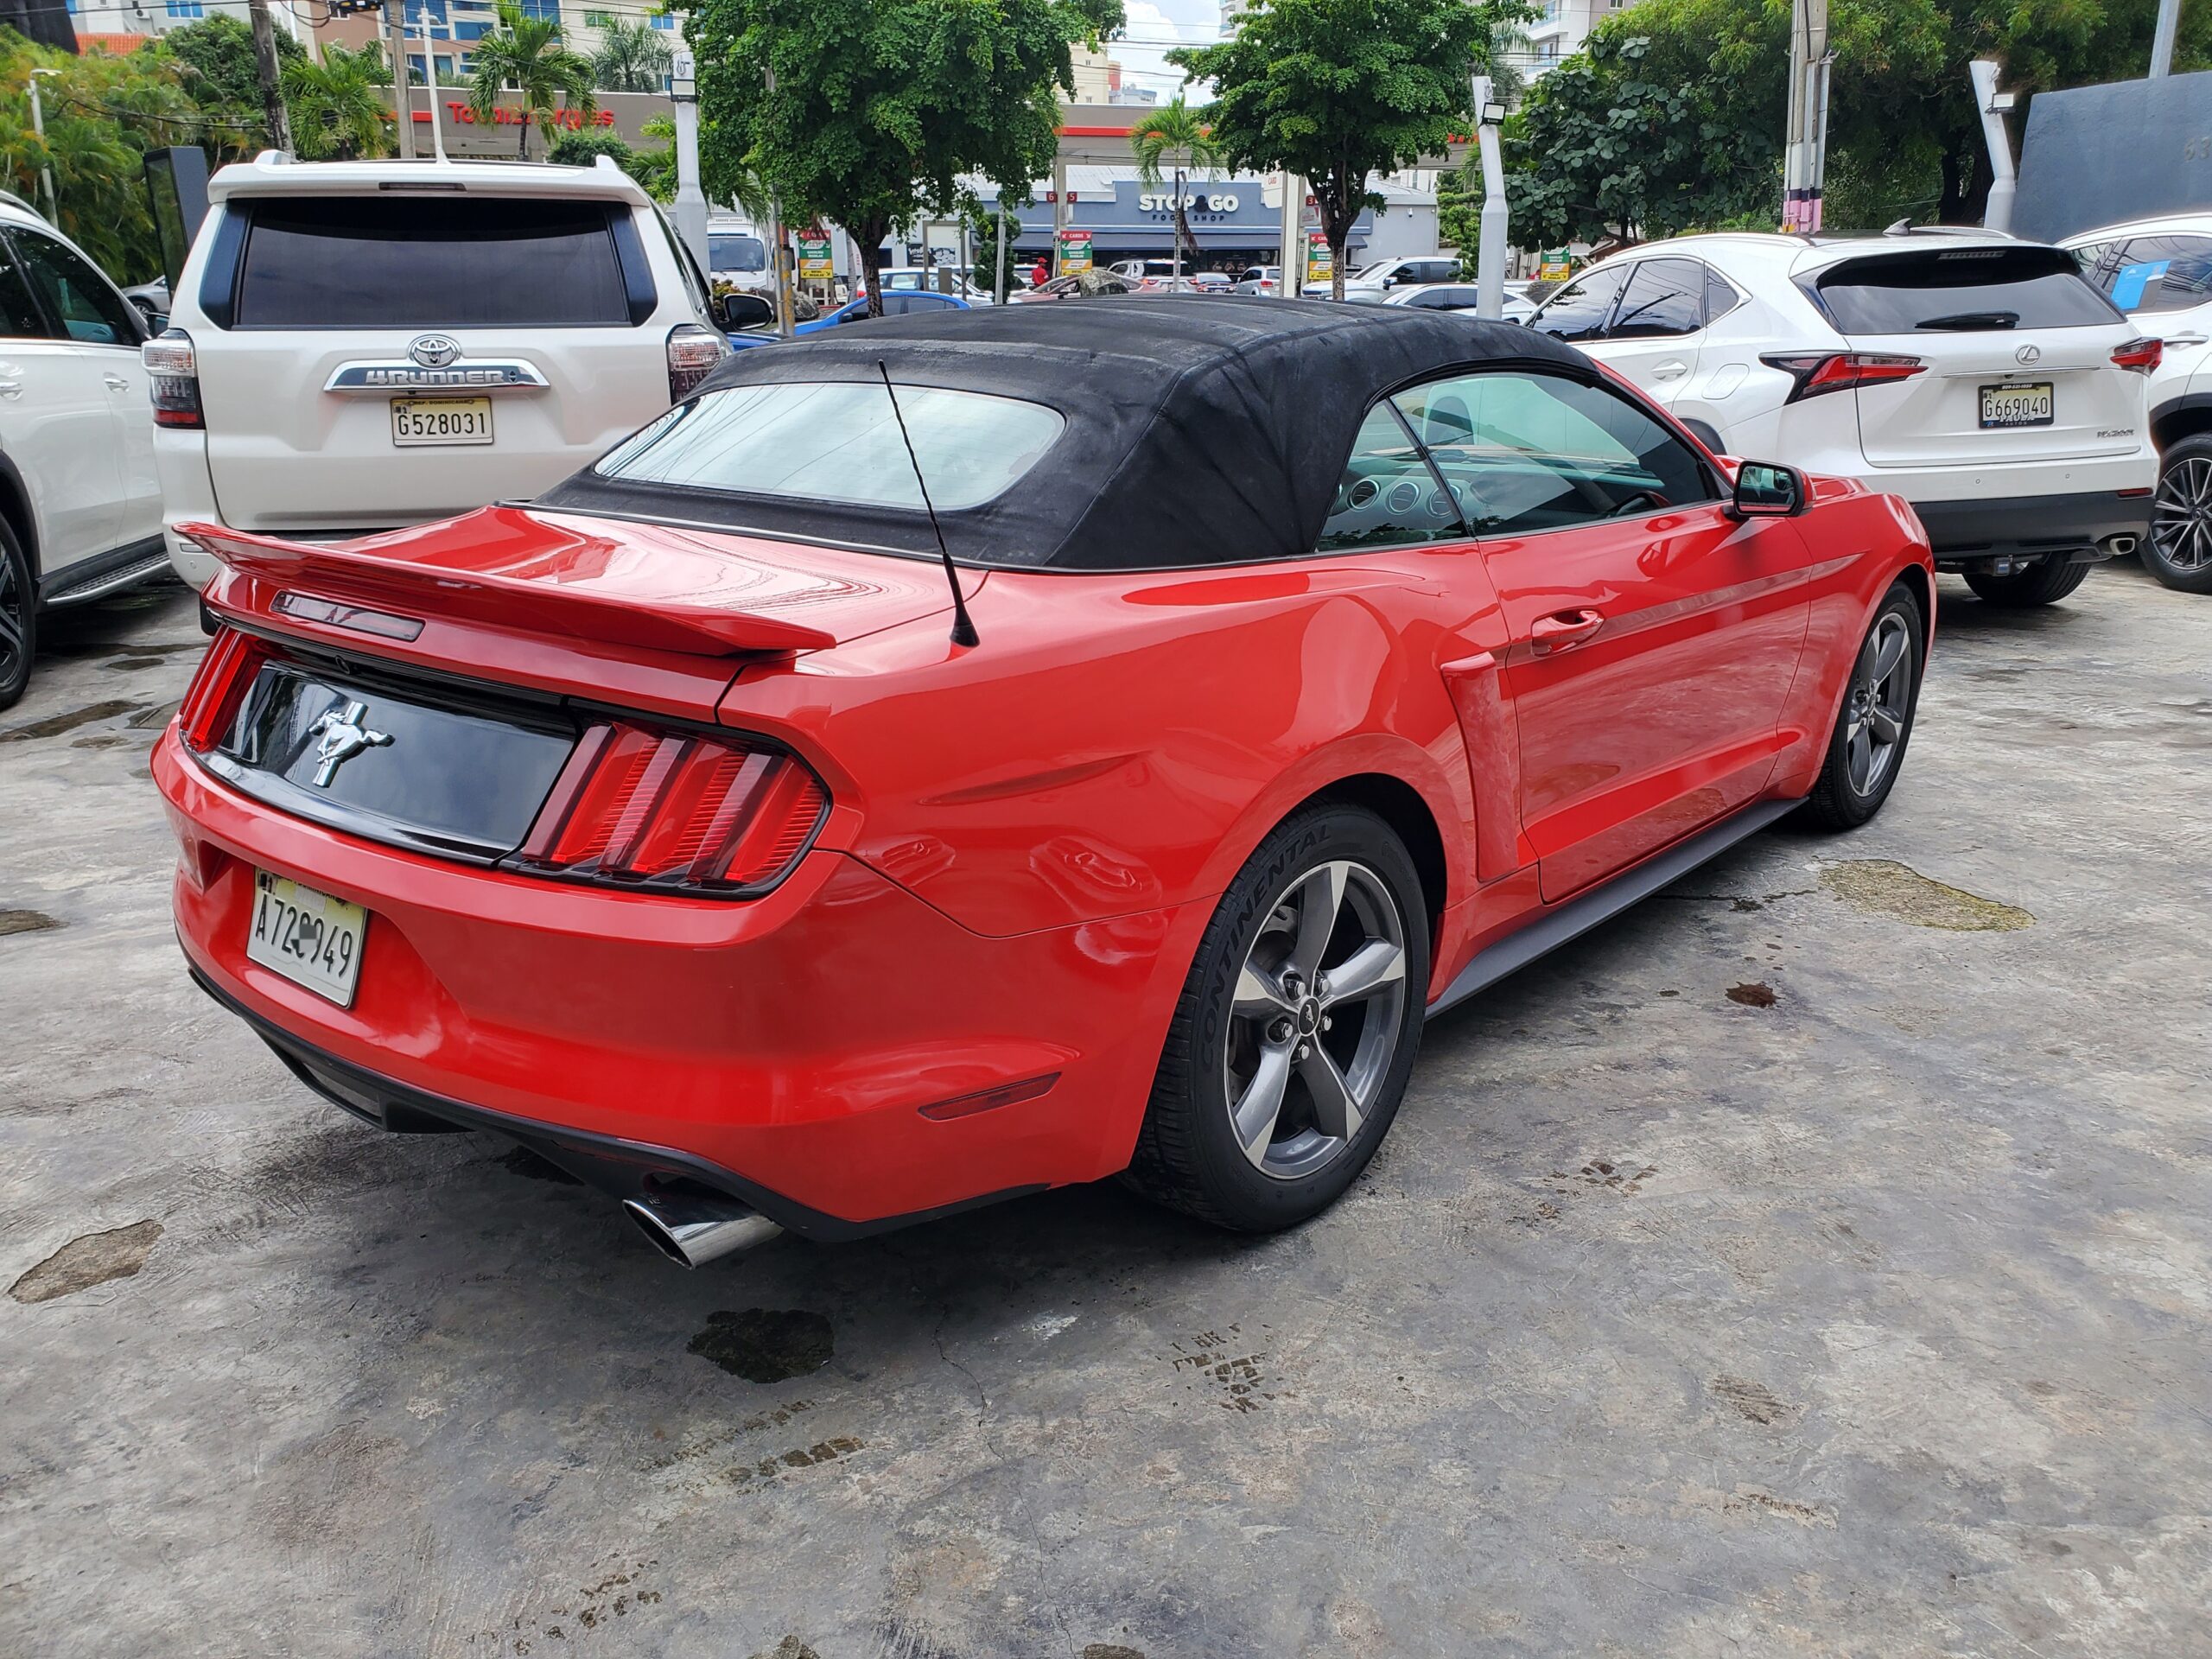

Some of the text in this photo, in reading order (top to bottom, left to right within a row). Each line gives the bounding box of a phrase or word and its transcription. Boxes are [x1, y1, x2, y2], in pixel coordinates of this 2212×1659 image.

[1048, 193, 1054, 201] 6
[1070, 193, 1075, 201] 5
[1307, 196, 1313, 205] 3
[1985, 397, 2048, 417] G669040
[397, 412, 486, 435] G528031
